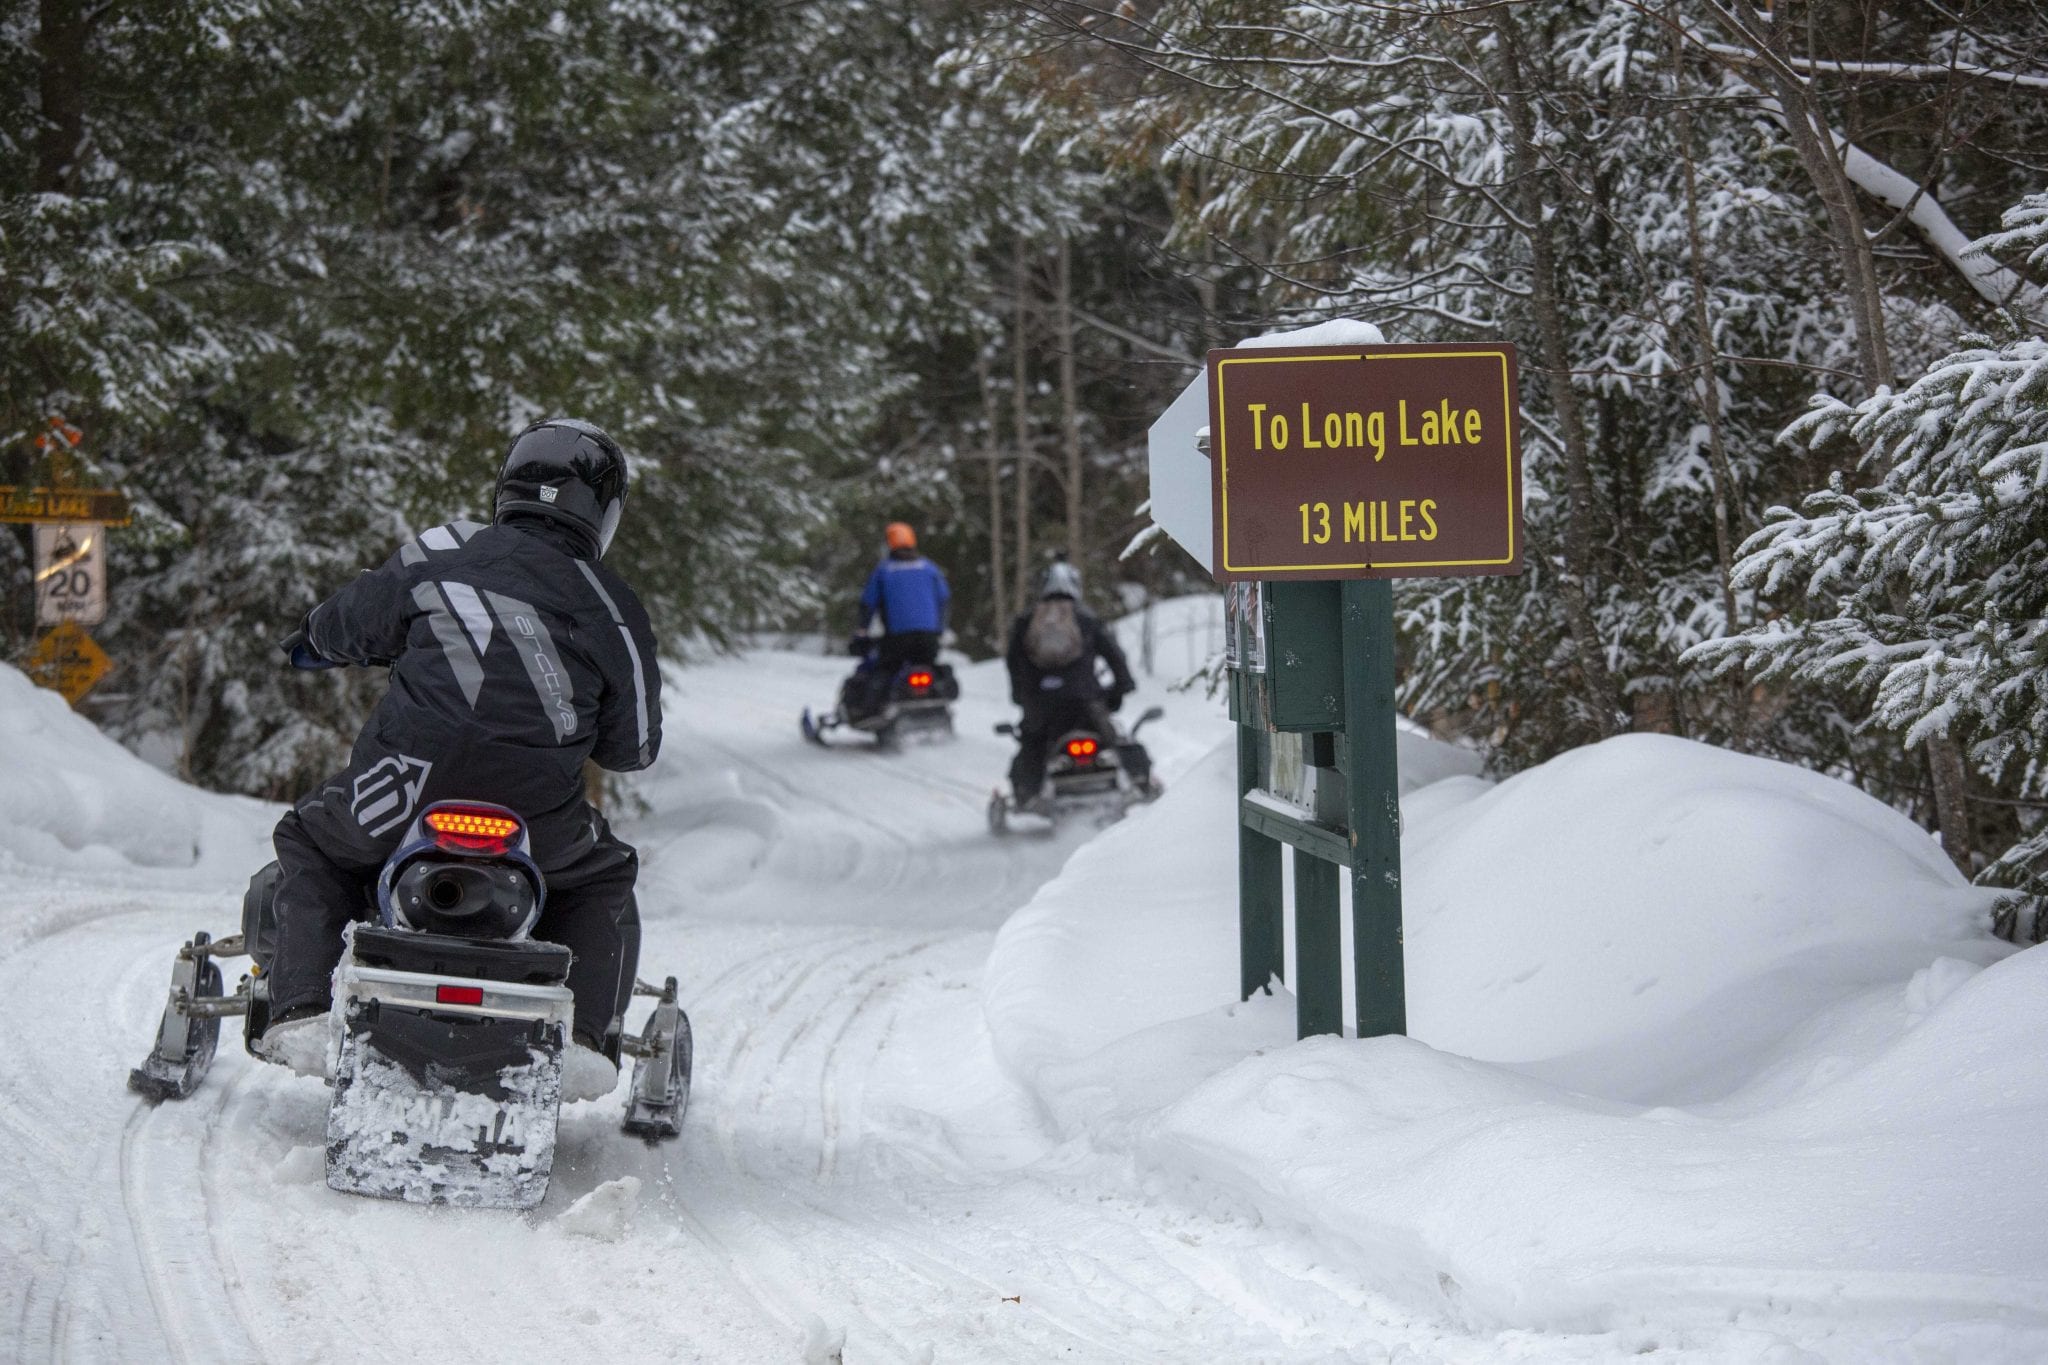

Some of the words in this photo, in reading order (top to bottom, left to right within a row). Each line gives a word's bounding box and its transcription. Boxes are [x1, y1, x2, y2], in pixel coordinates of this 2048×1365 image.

[1248, 404, 1288, 450] To
[1302, 403, 1385, 462] Long
[1399, 398, 1482, 445] Lake
[1299, 502, 1332, 544] 13
[1344, 499, 1438, 543] MILES
[50, 570, 90, 597] 20
